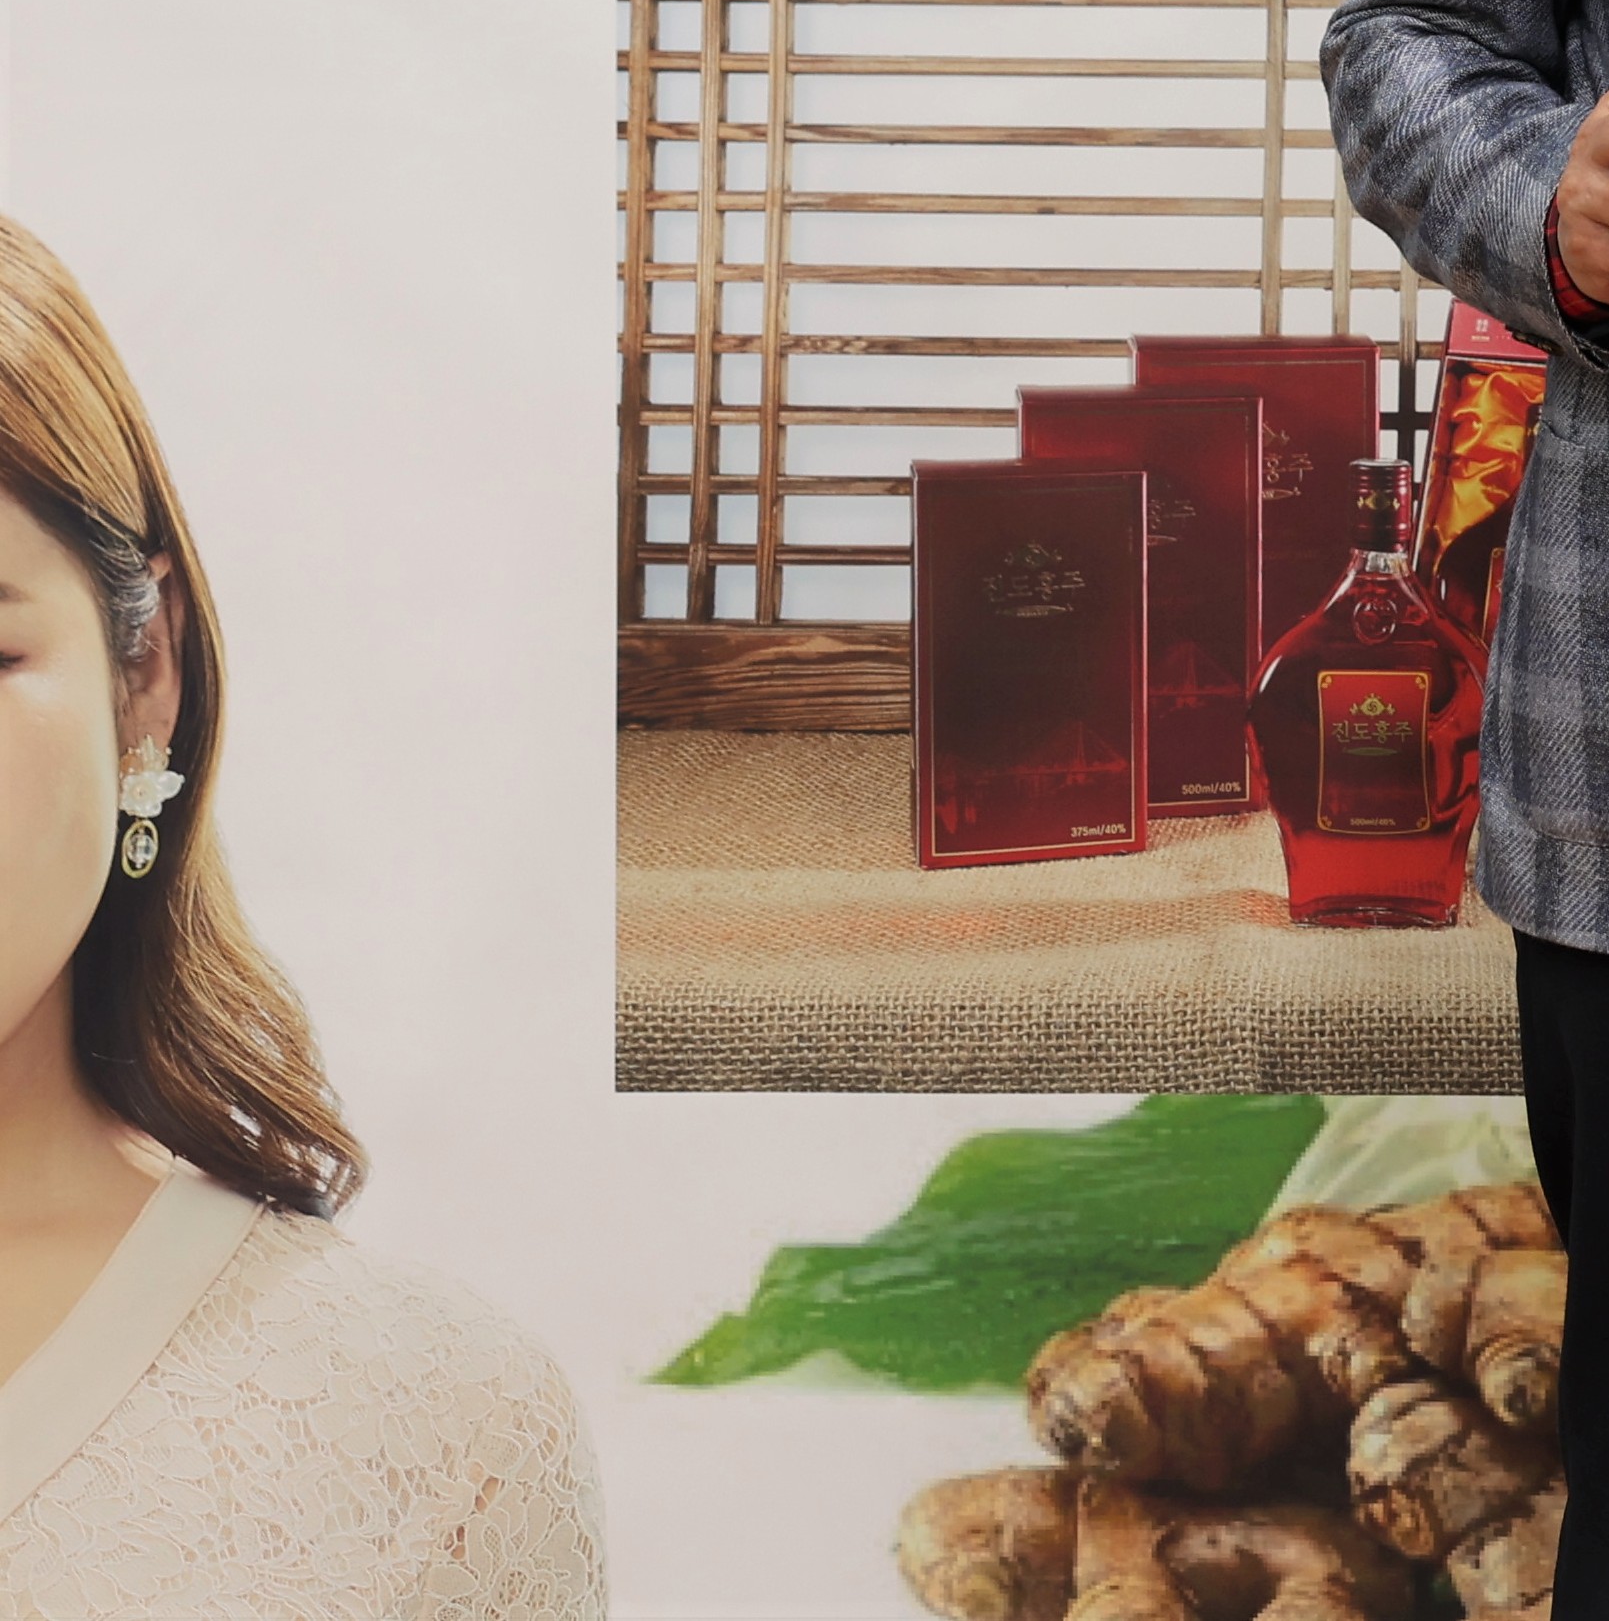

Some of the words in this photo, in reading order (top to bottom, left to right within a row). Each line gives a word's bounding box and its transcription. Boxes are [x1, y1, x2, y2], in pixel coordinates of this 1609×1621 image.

[1331, 719, 1414, 745] 진도홍주
[1182, 781, 1242, 795] 500ml/40%
[1070, 823, 1126, 838] 375ml/40%
